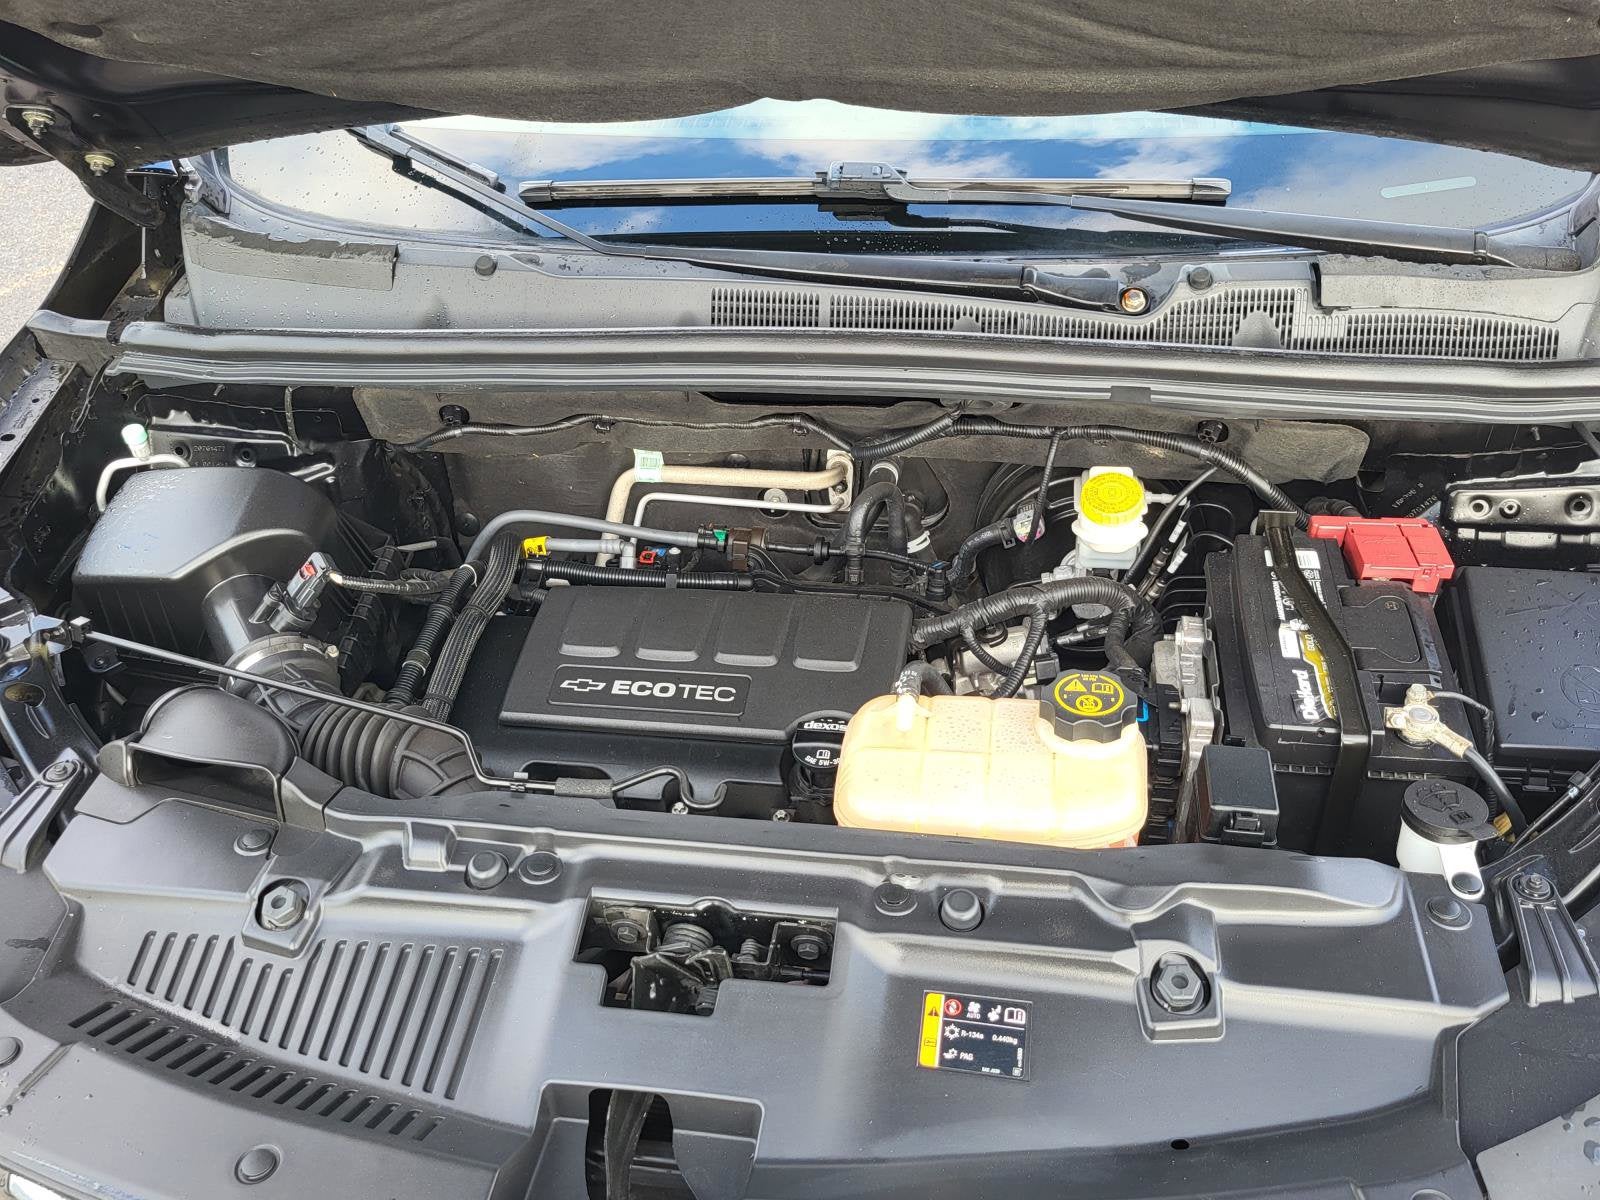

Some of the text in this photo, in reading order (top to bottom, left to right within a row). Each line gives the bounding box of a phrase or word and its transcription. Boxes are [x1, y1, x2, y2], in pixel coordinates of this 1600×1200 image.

[611, 679, 737, 702] ECOTEC
[1292, 669, 1320, 720] DieHard
[804, 755, 817, 765] SAE
[960, 1029, 984, 1039] R-134a
[959, 1051, 974, 1061] PAG
